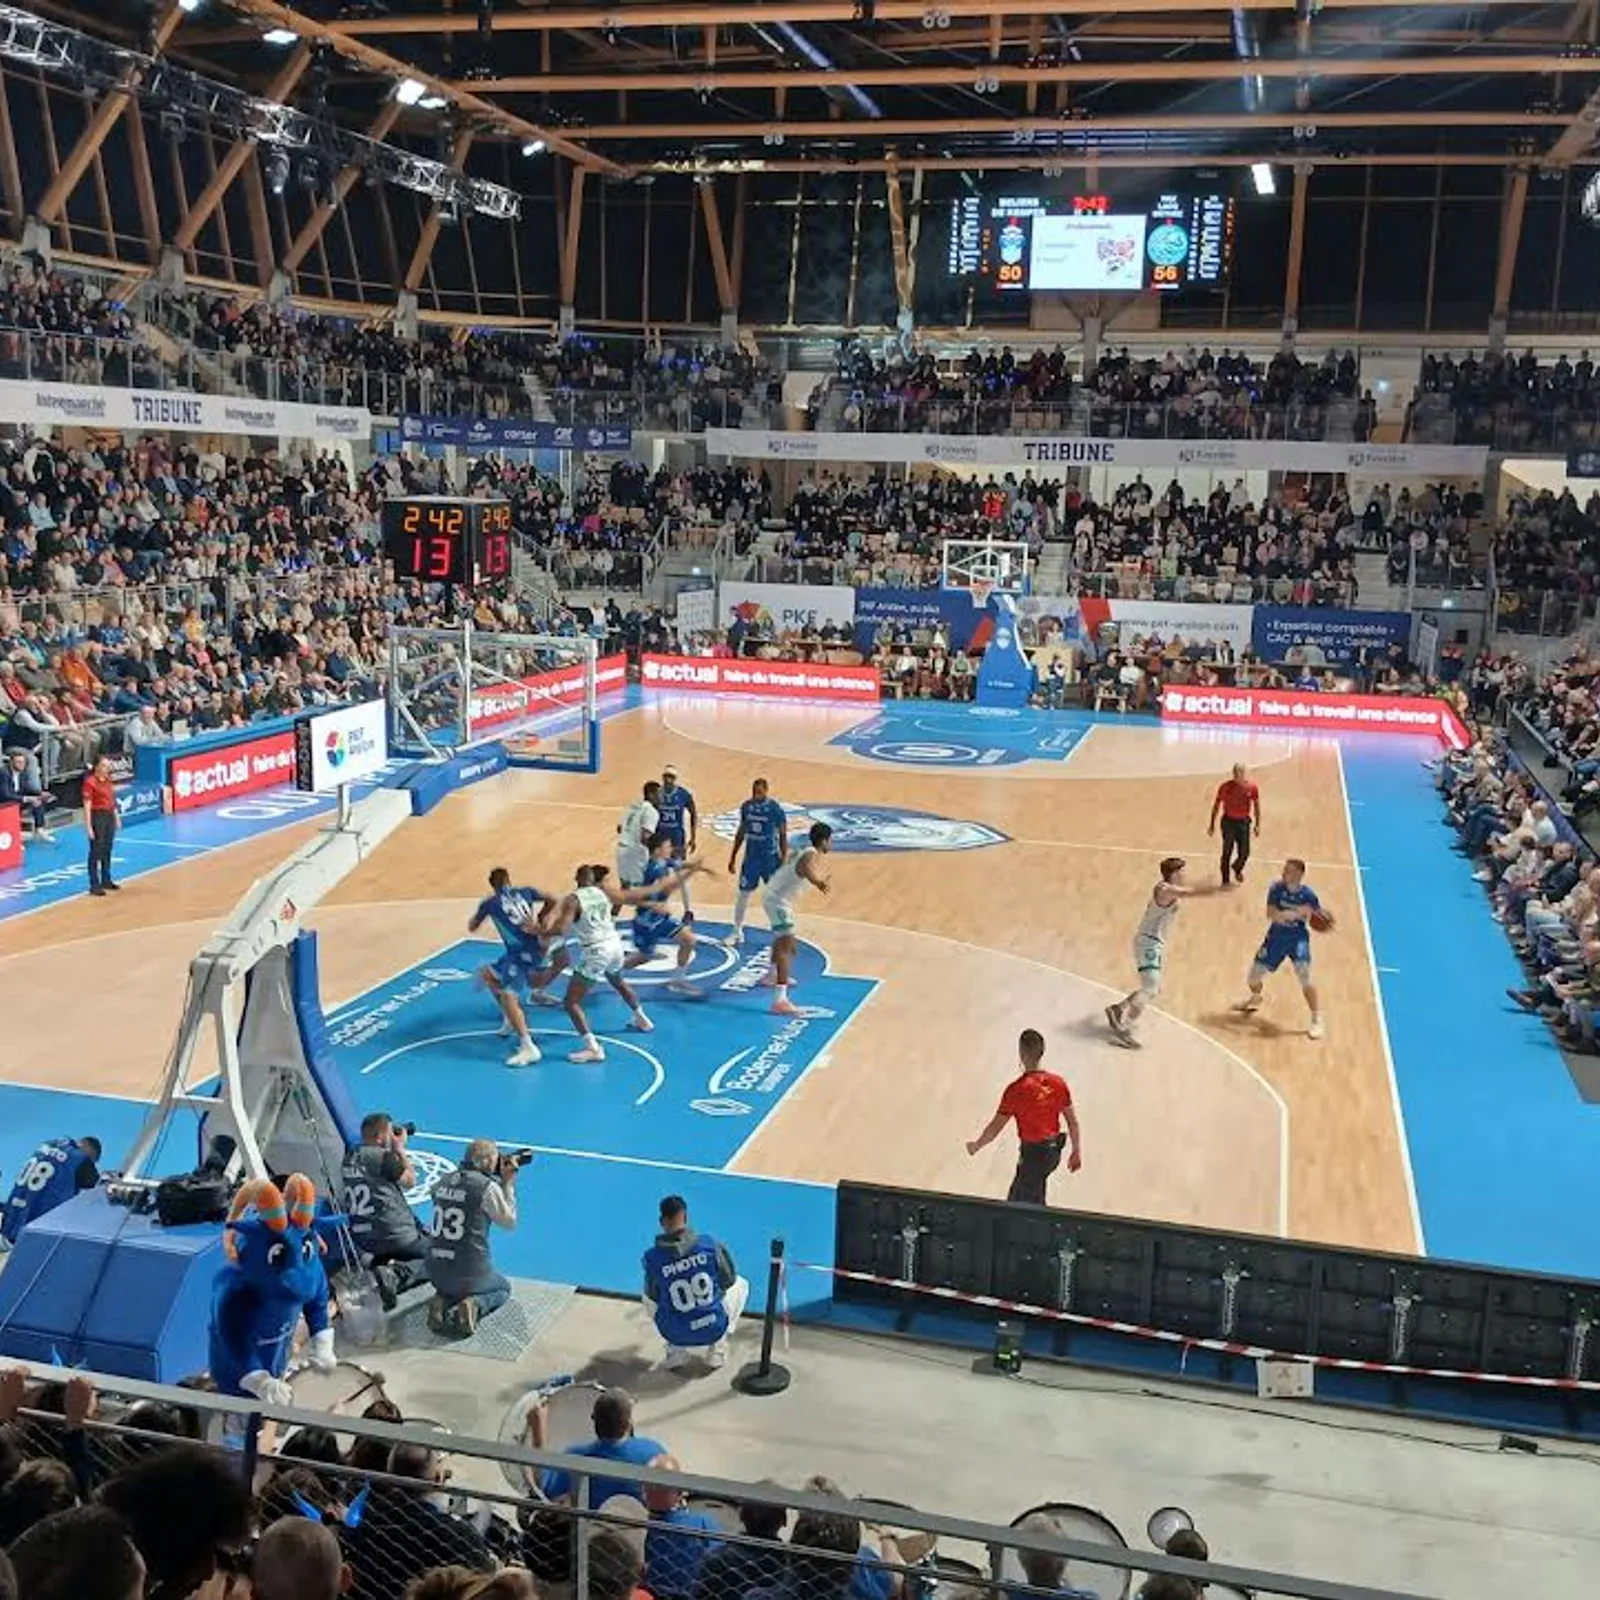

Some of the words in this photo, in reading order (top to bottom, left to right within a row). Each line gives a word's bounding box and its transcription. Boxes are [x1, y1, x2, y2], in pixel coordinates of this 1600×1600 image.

[999, 264, 1022, 281] 50
[1153, 264, 1178, 281] 56
[132, 396, 202, 425] TRIBUNE
[1023, 442, 1115, 462] TRIBUNE
[412, 538, 451, 576] 13
[486, 535, 507, 574] 13
[1266, 633, 1290, 644] CAC
[1273, 620, 1323, 632] Expertise
[660, 664, 718, 684] actual
[751, 670, 768, 684] du
[1185, 696, 1252, 716] actual
[1259, 703, 1290, 716] faire
[1292, 702, 1311, 717] du
[193, 753, 250, 795] actual
[16, 1157, 56, 1191] 08
[344, 1183, 375, 1216] 02
[430, 1205, 466, 1240] 03
[661, 1253, 707, 1278] PHOTO
[669, 1272, 714, 1313] 09
